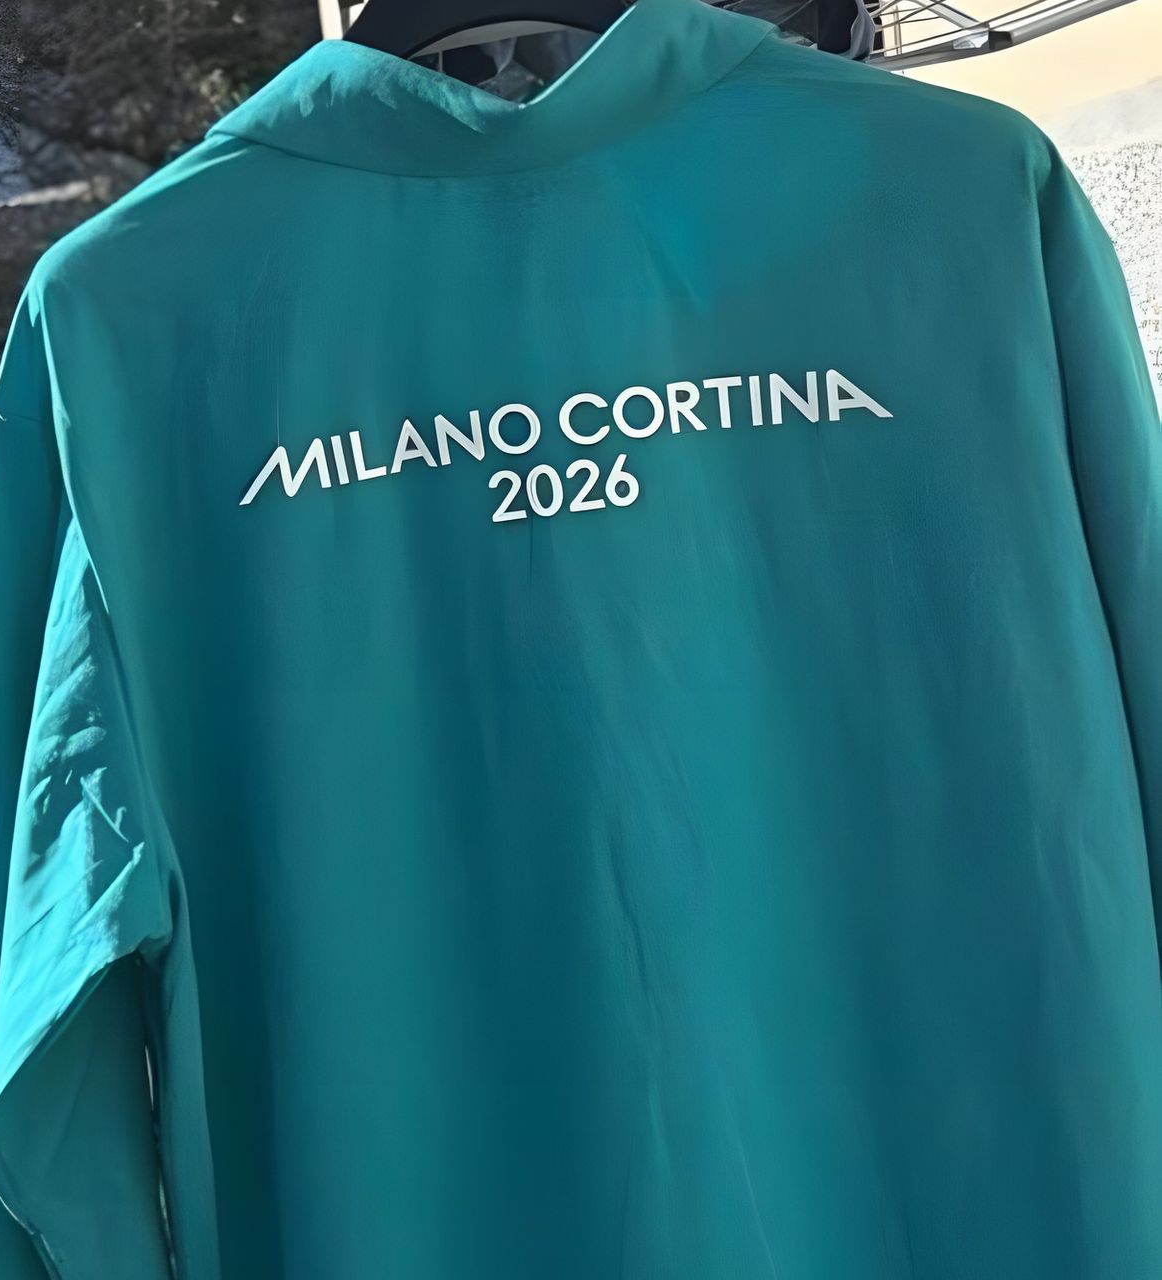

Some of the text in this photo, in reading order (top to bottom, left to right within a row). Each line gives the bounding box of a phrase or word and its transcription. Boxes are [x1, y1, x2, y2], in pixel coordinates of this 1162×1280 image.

[239, 368, 894, 506] MILANO CORTINA
[488, 453, 640, 523] 2026
